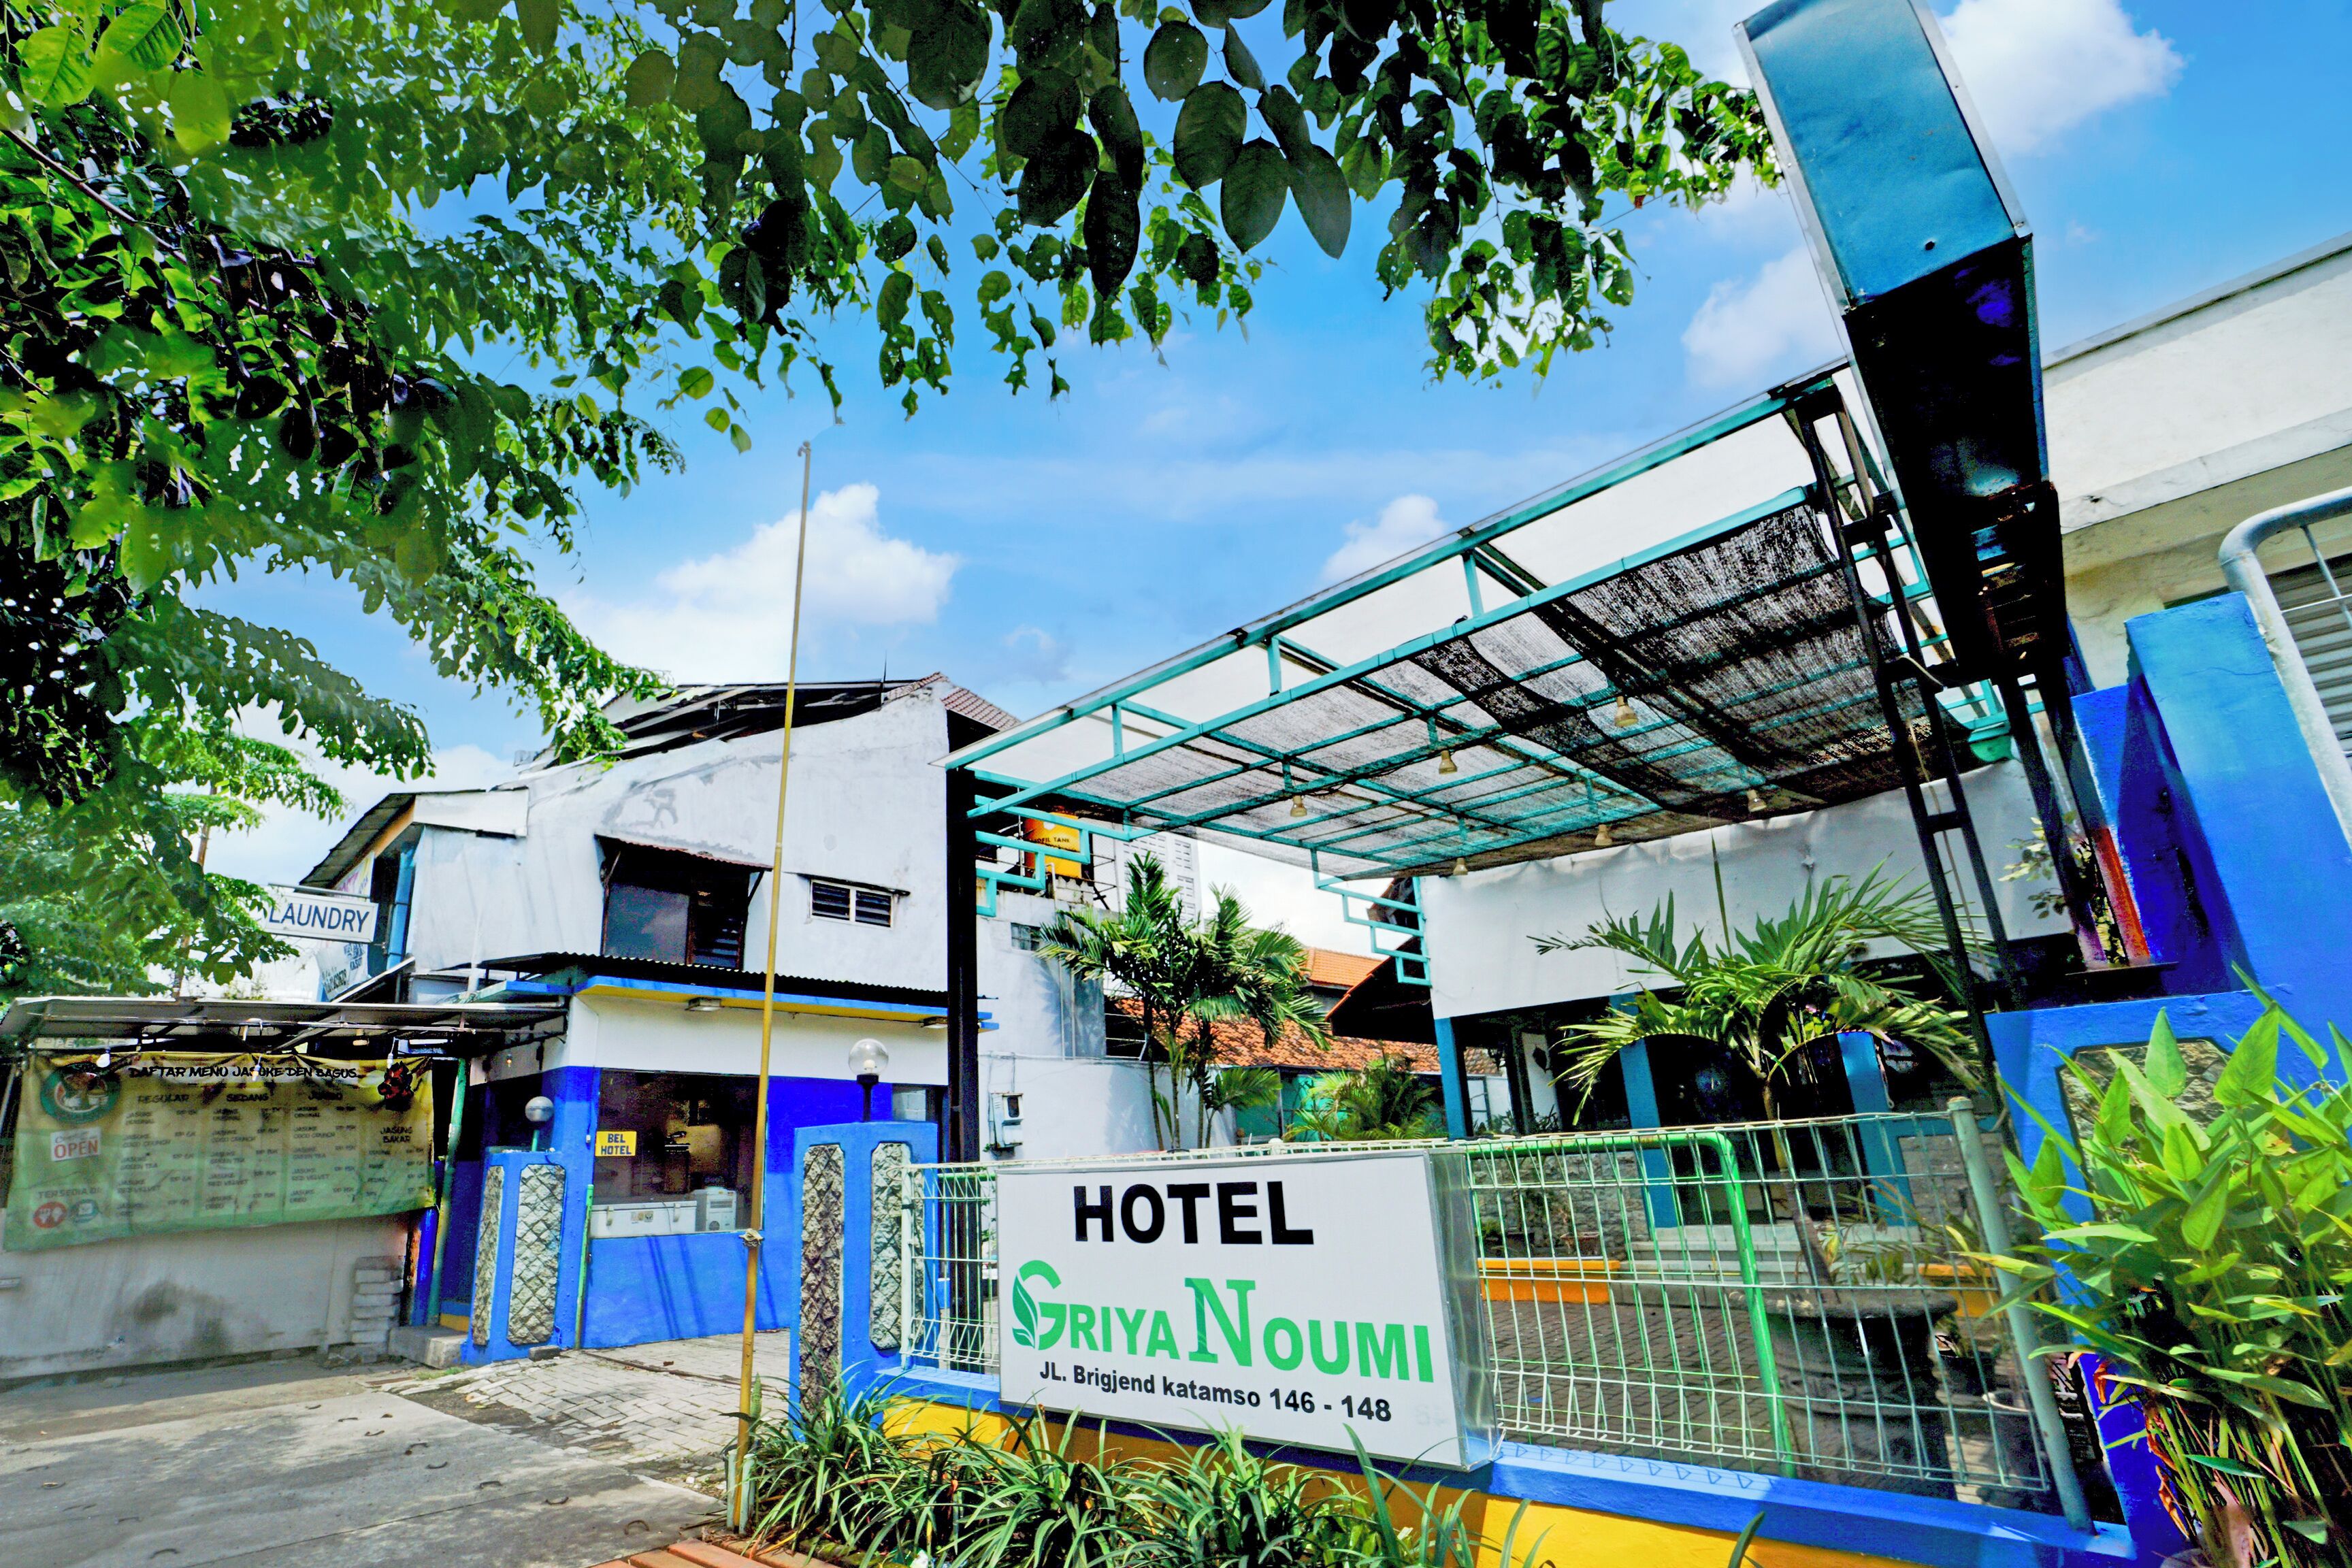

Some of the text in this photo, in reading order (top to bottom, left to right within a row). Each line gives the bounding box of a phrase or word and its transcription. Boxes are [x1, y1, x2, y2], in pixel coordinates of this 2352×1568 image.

[268, 902, 370, 932] LAUNDRY
[129, 1066, 186, 1077] DAFTAR
[189, 1066, 228, 1077] MENU
[285, 1066, 312, 1077] DEN
[316, 1068, 357, 1079] BAGUS
[226, 1094, 269, 1102] SEDANG
[608, 1133, 625, 1143] BEL
[54, 1139, 99, 1158] OPEN
[601, 1145, 632, 1155] HOTEL
[1073, 1181, 1314, 1245] HOTEL
[1012, 1259, 1435, 1383] GRIYA NOUMI
[1039, 1362, 1066, 1382] JL.
[1073, 1367, 1156, 1396] Brigjend
[1162, 1377, 1260, 1409] katamso
[1269, 1389, 1315, 1414] 146
[1341, 1395, 1392, 1422] 148
